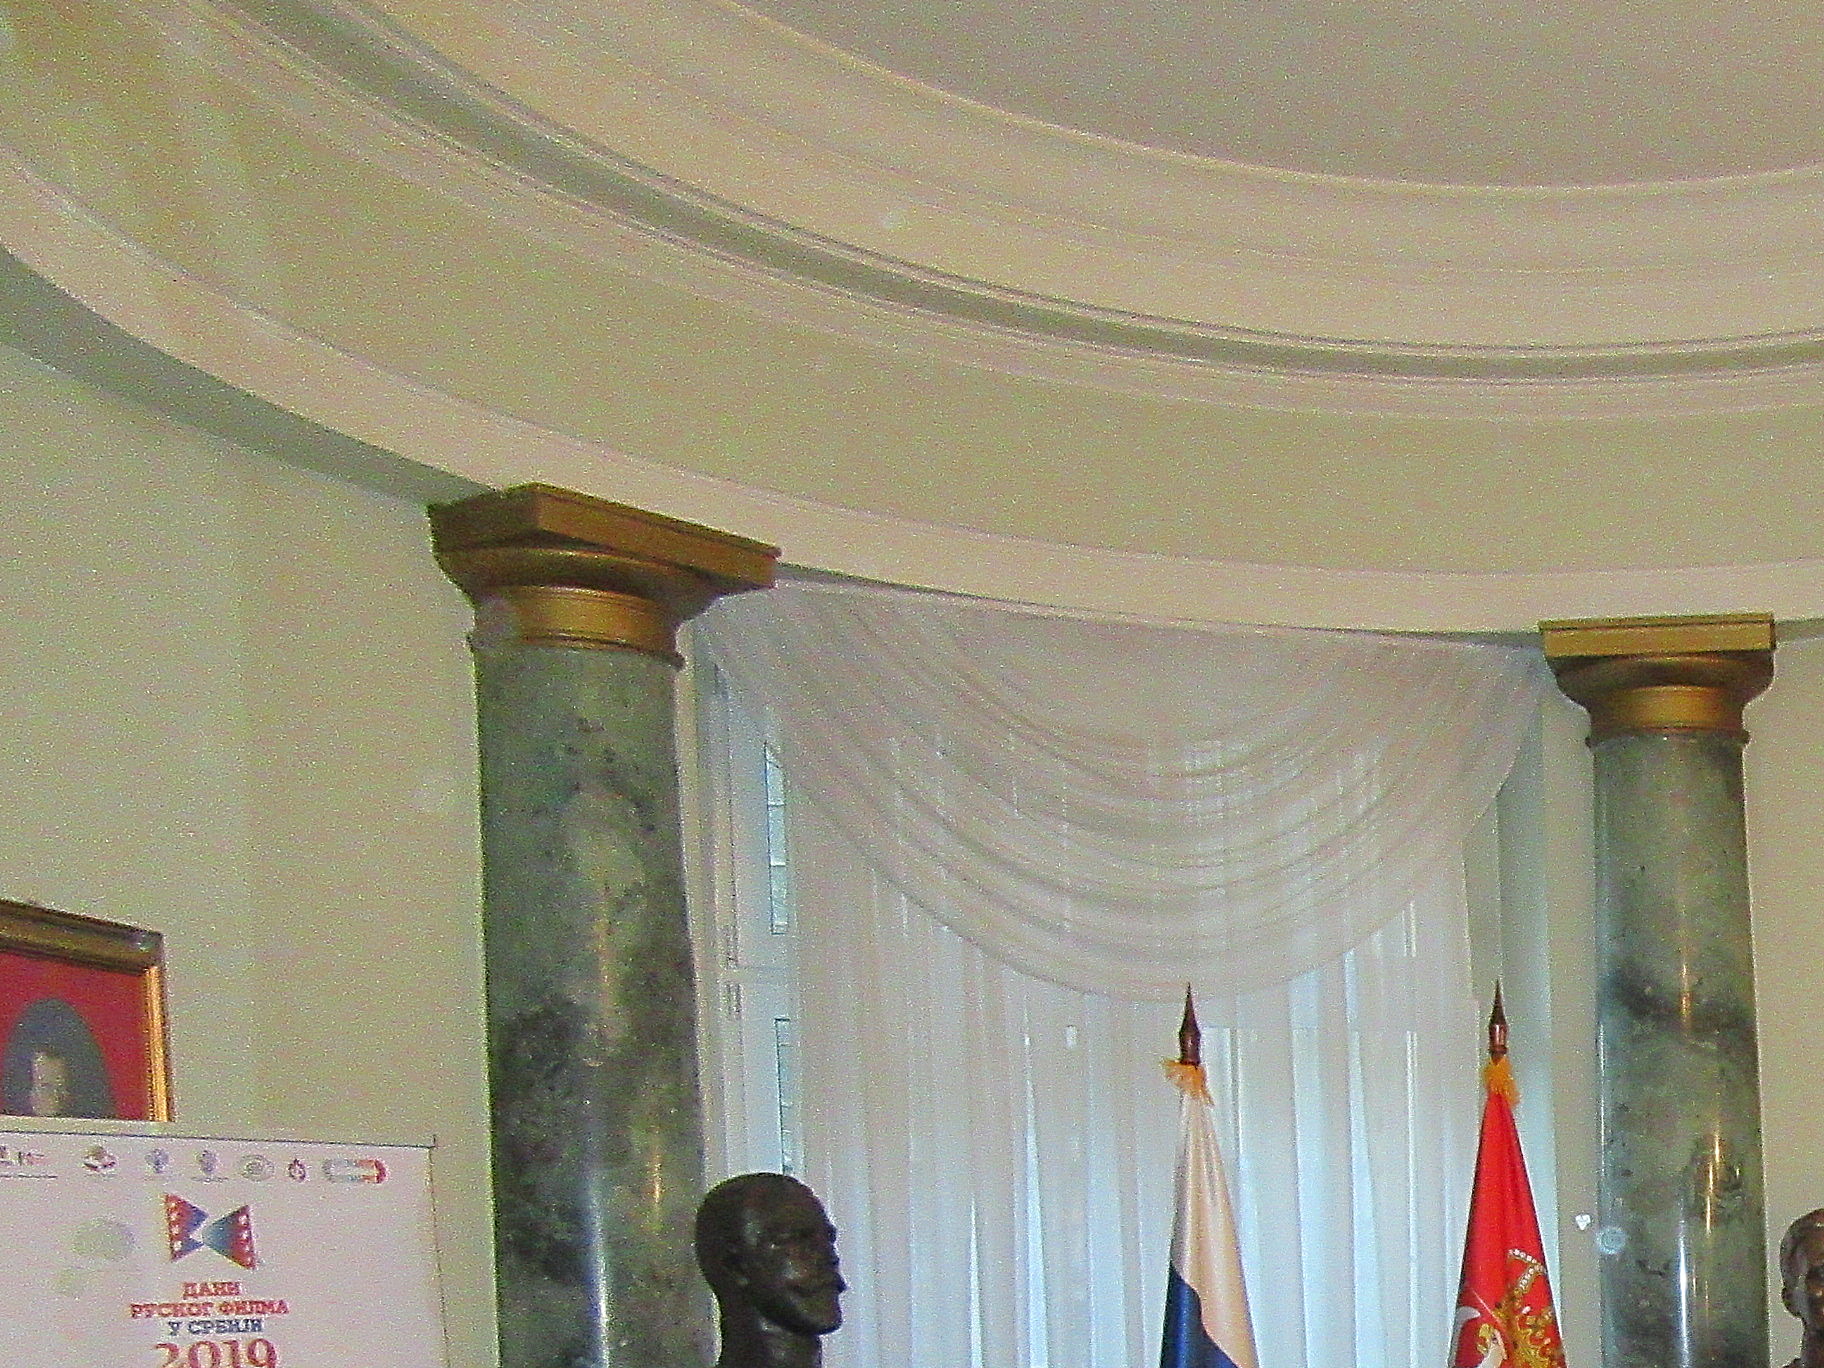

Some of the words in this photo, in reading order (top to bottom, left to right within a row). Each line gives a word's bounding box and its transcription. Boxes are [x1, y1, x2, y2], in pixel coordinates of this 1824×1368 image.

[182, 1281, 242, 1300] ДАНИ
[130, 1301, 214, 1319] РУСКОГ
[167, 1321, 183, 1337] У
[187, 1318, 265, 1335] СРБИЈИ
